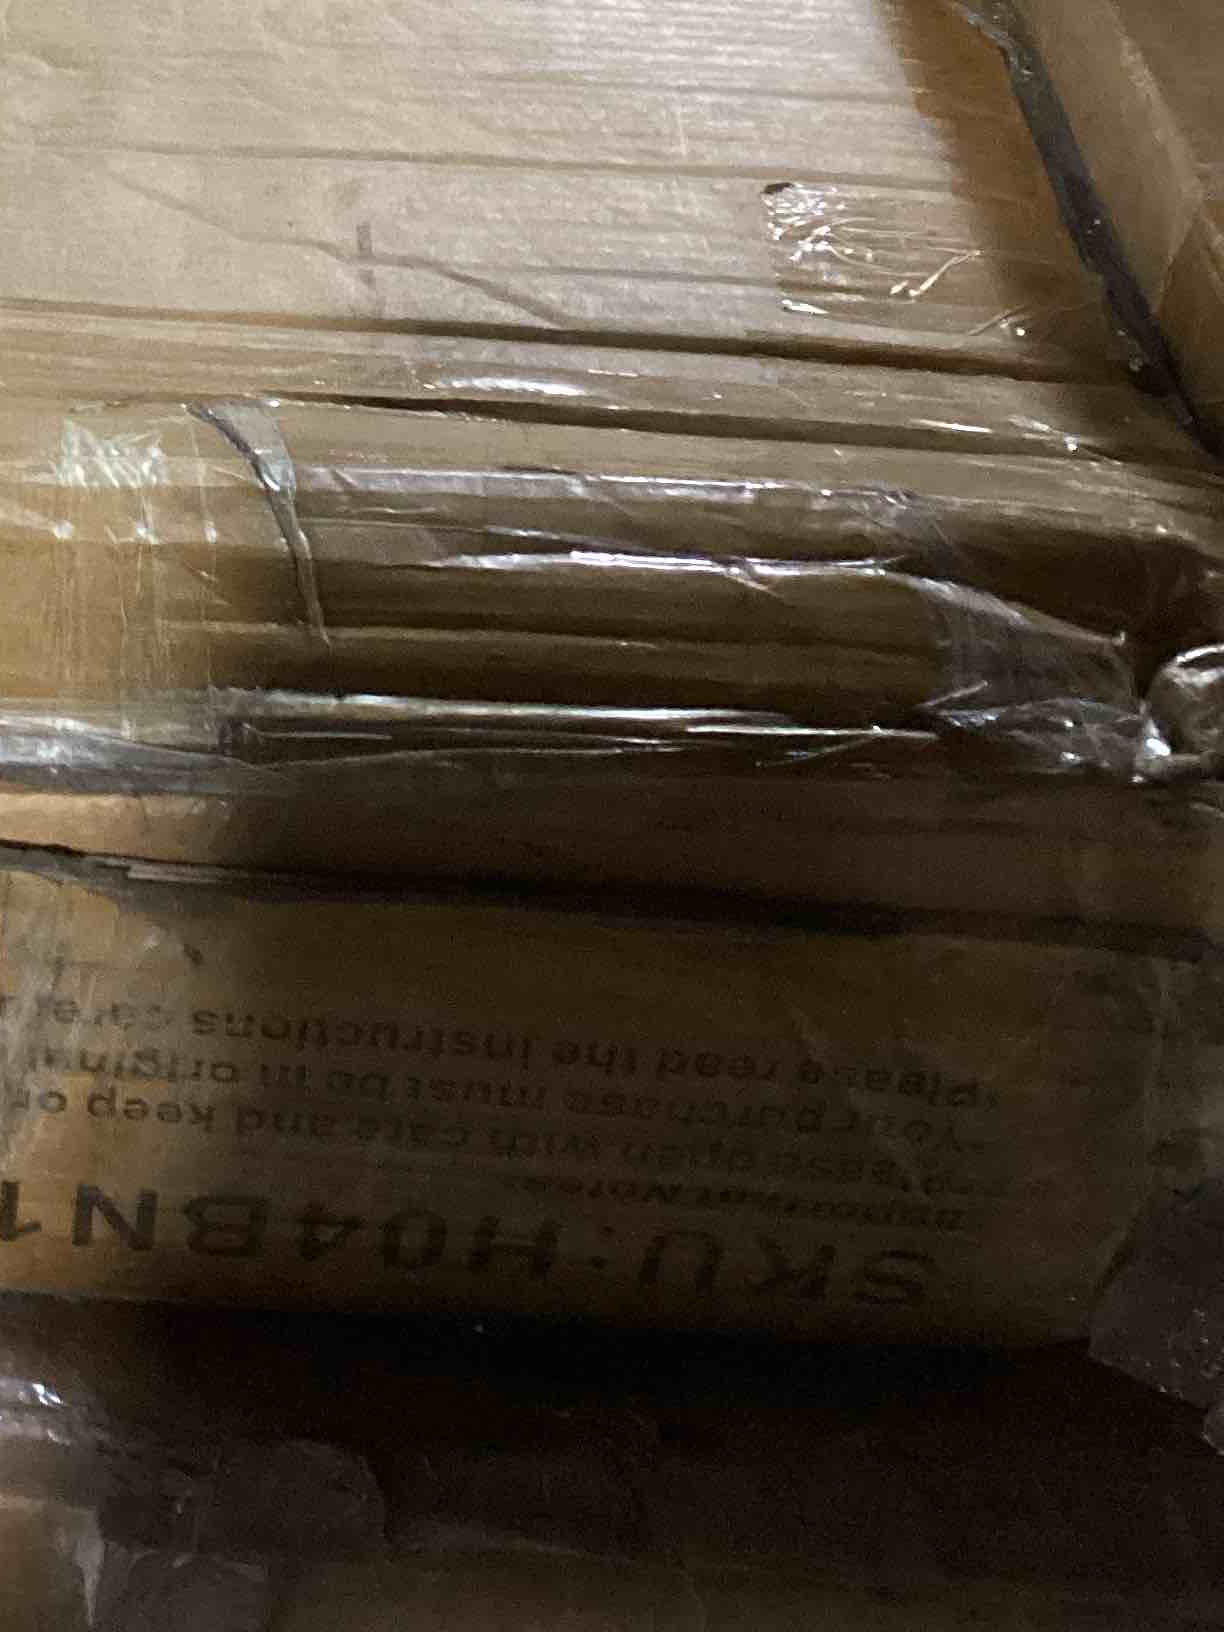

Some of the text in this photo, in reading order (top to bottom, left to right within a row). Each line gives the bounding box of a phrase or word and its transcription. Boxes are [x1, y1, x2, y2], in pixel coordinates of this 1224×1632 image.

[190, 1008, 532, 1072] instructions
[551, 1039, 637, 1079] the
[655, 1047, 777, 1085] read
[86, 1087, 217, 1134] keep
[236, 1105, 338, 1143] and
